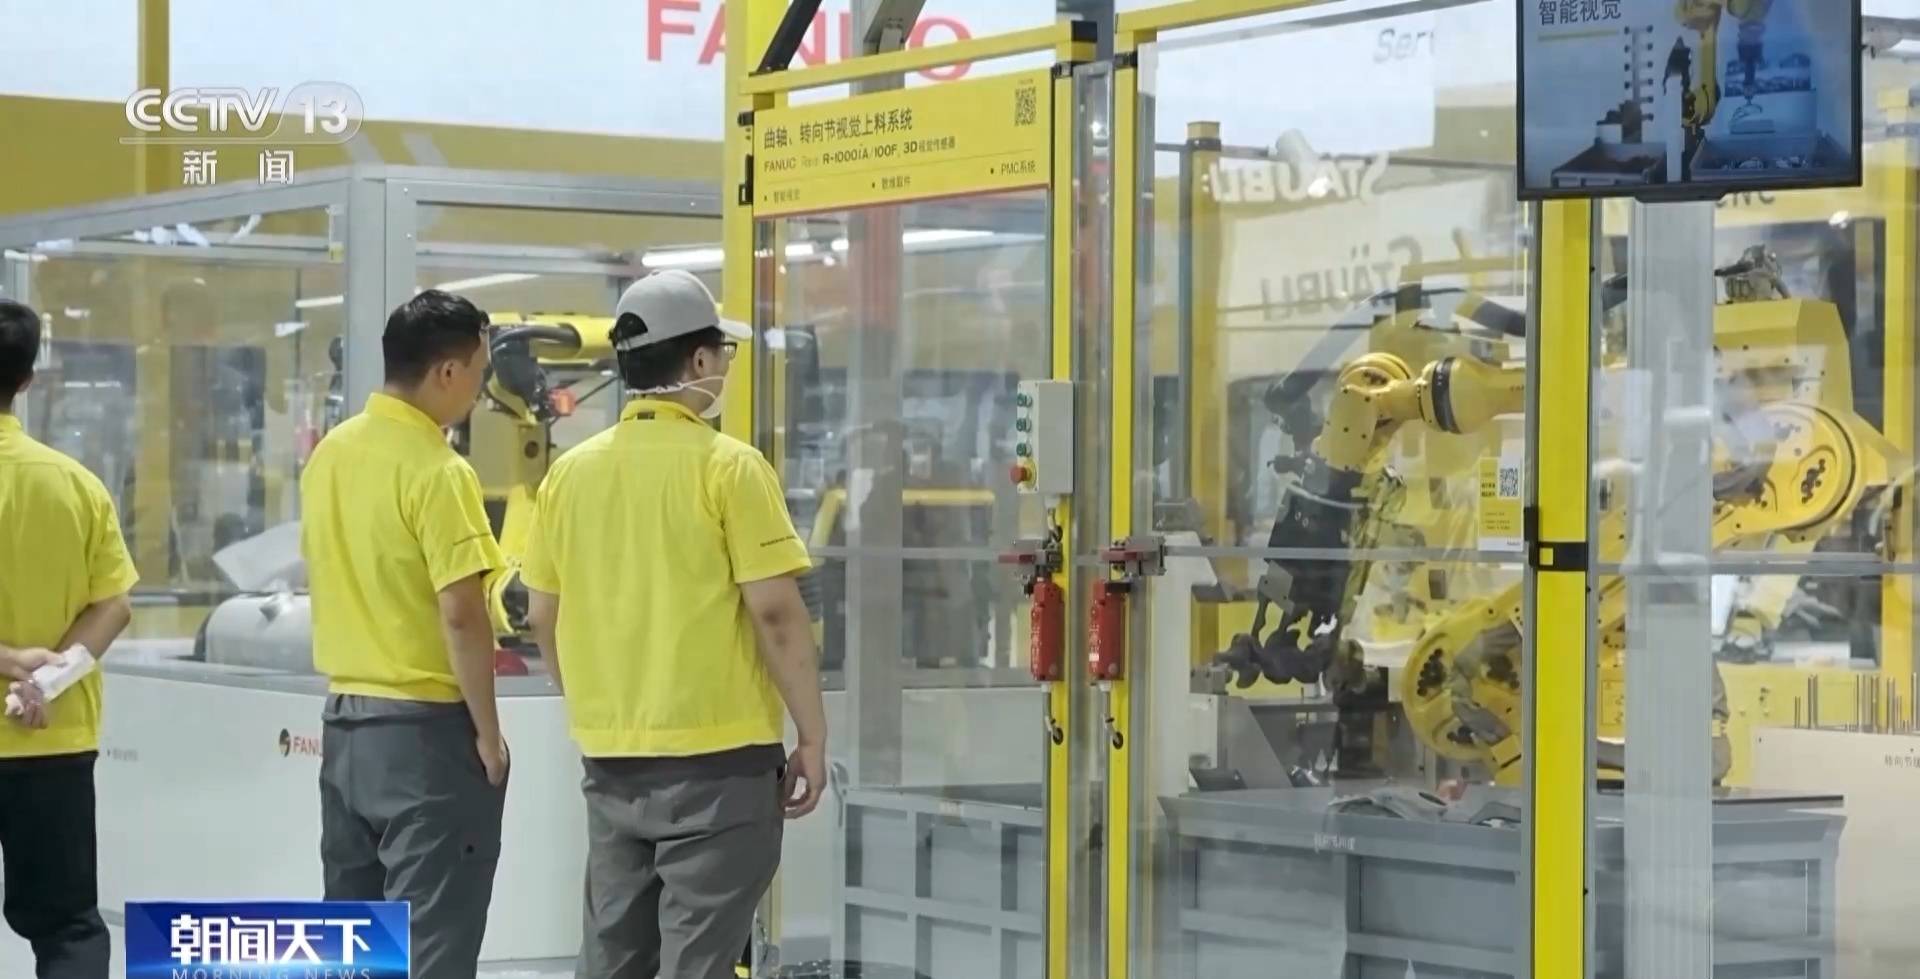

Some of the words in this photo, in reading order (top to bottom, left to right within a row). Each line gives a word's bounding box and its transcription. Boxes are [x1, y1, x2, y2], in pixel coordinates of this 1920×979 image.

[1539, 0, 1621, 25] 智能视觉
[763, 107, 914, 150] 曲轴、转向节视觉上料系统
[764, 157, 796, 172] FANUC
[1001, 161, 1036, 176] PMC系统
